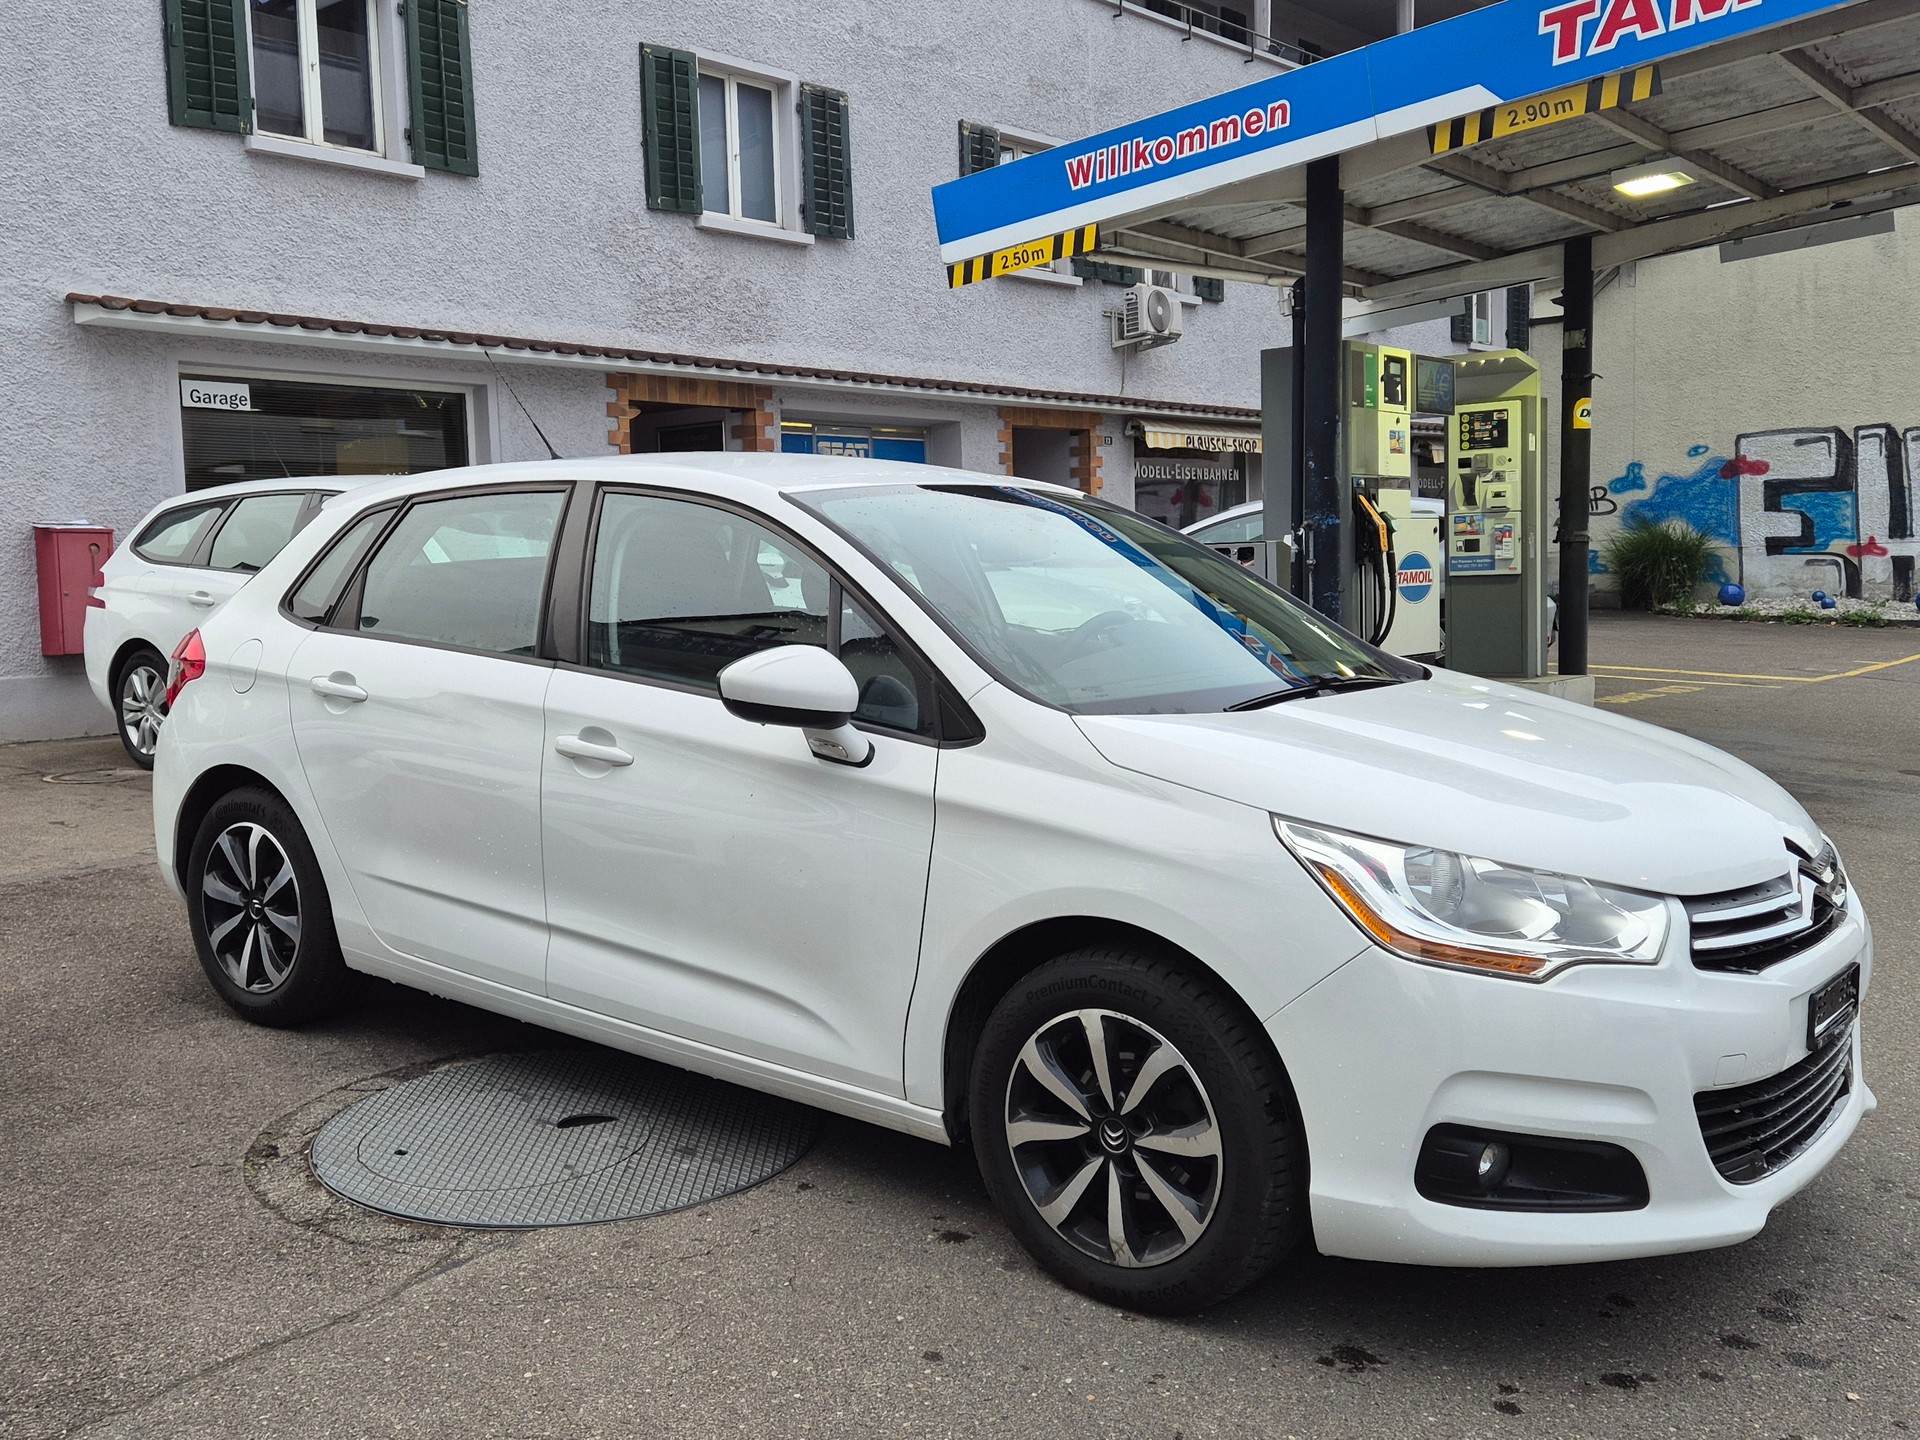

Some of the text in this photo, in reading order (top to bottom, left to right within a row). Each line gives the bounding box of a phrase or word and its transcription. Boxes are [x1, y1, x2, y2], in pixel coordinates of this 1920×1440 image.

[1065, 100, 1290, 190] Willkommen
[190, 388, 248, 409] Garage
[1397, 571, 1433, 584] TAMOIL
[1025, 974, 1148, 1005] PremiumContact
